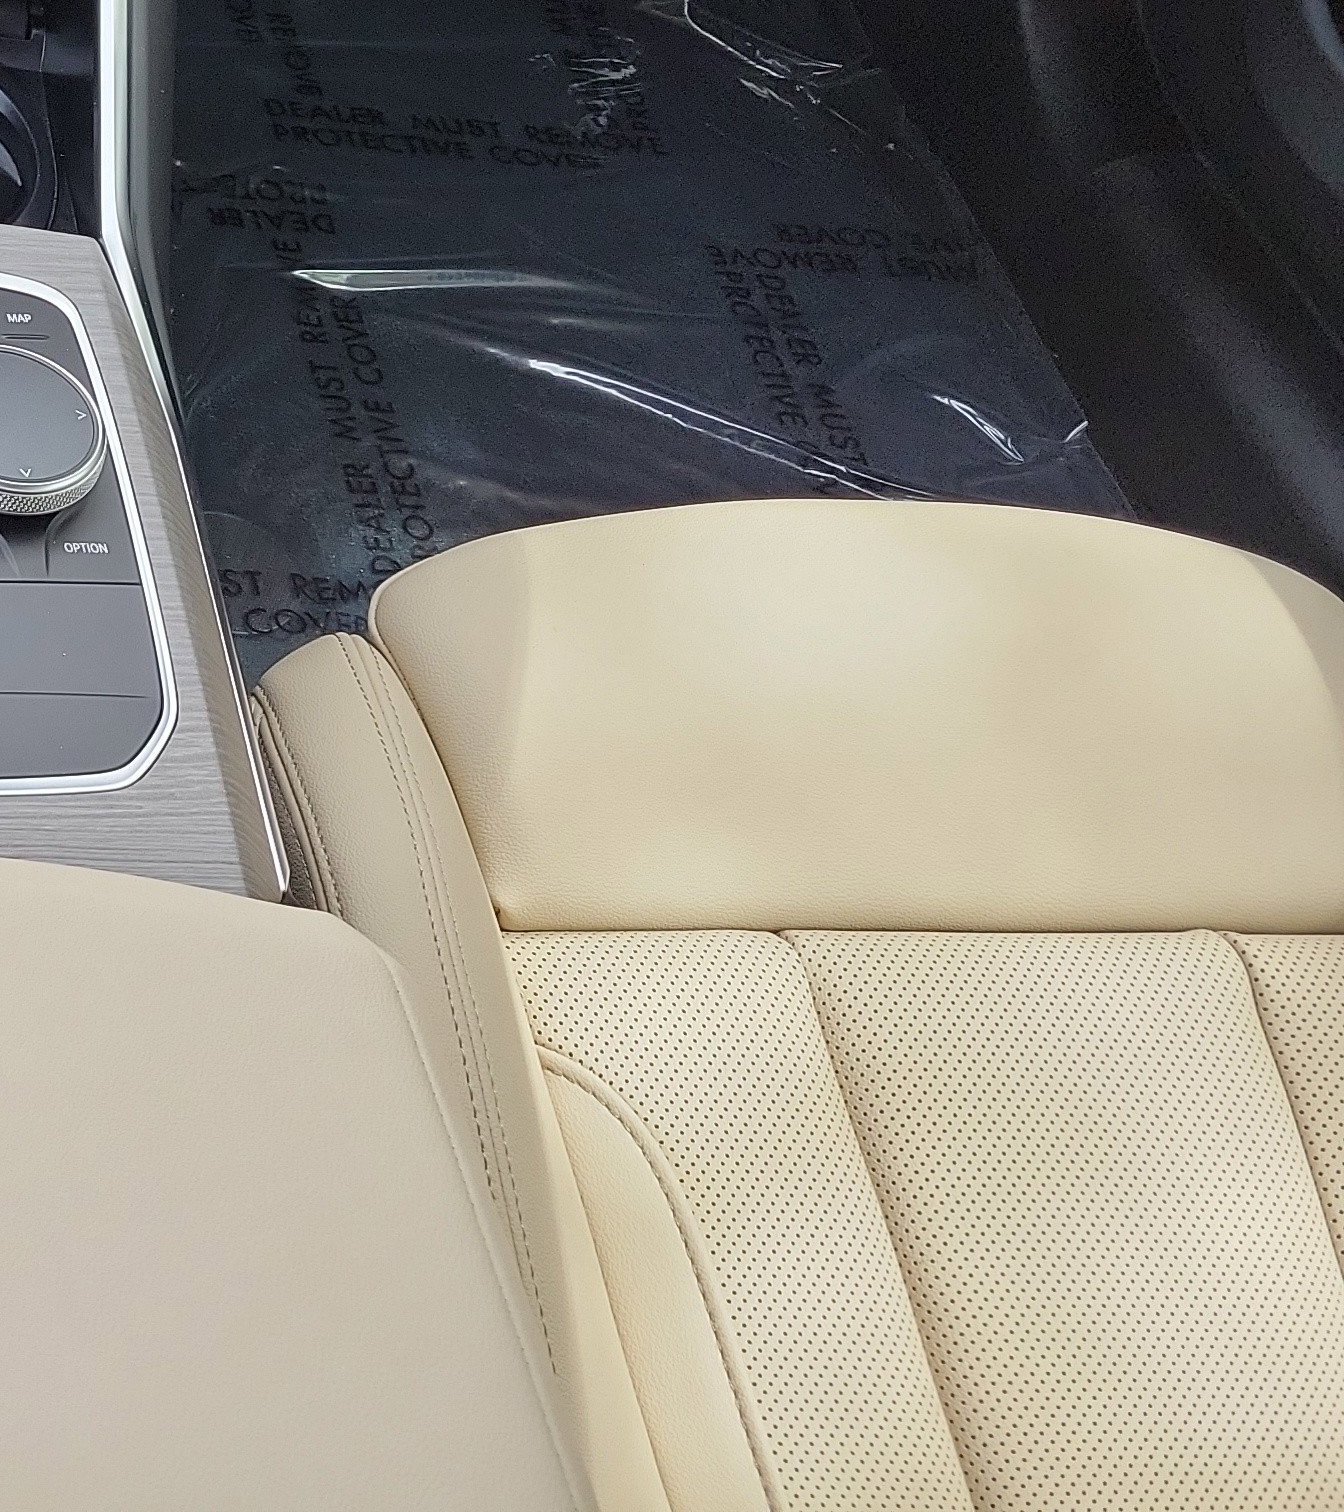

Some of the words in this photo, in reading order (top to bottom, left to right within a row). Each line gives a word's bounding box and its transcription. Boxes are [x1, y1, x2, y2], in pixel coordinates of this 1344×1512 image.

[262, 97, 390, 127] DEALER
[411, 113, 502, 140] MUST
[523, 124, 670, 157] REMOVE
[272, 122, 476, 161] PROTECTIVE
[703, 244, 859, 274] REMOVE
[772, 222, 892, 249] COVER
[7, 313, 32, 324] MAP
[328, 295, 385, 387] COVER
[713, 269, 810, 428] PROTECTIVE
[755, 272, 824, 367] DEALER
[807, 382, 870, 468] MUST
[308, 358, 362, 444] MUST
[64, 542, 109, 554] OPTION
[342, 460, 403, 577] DEALER
